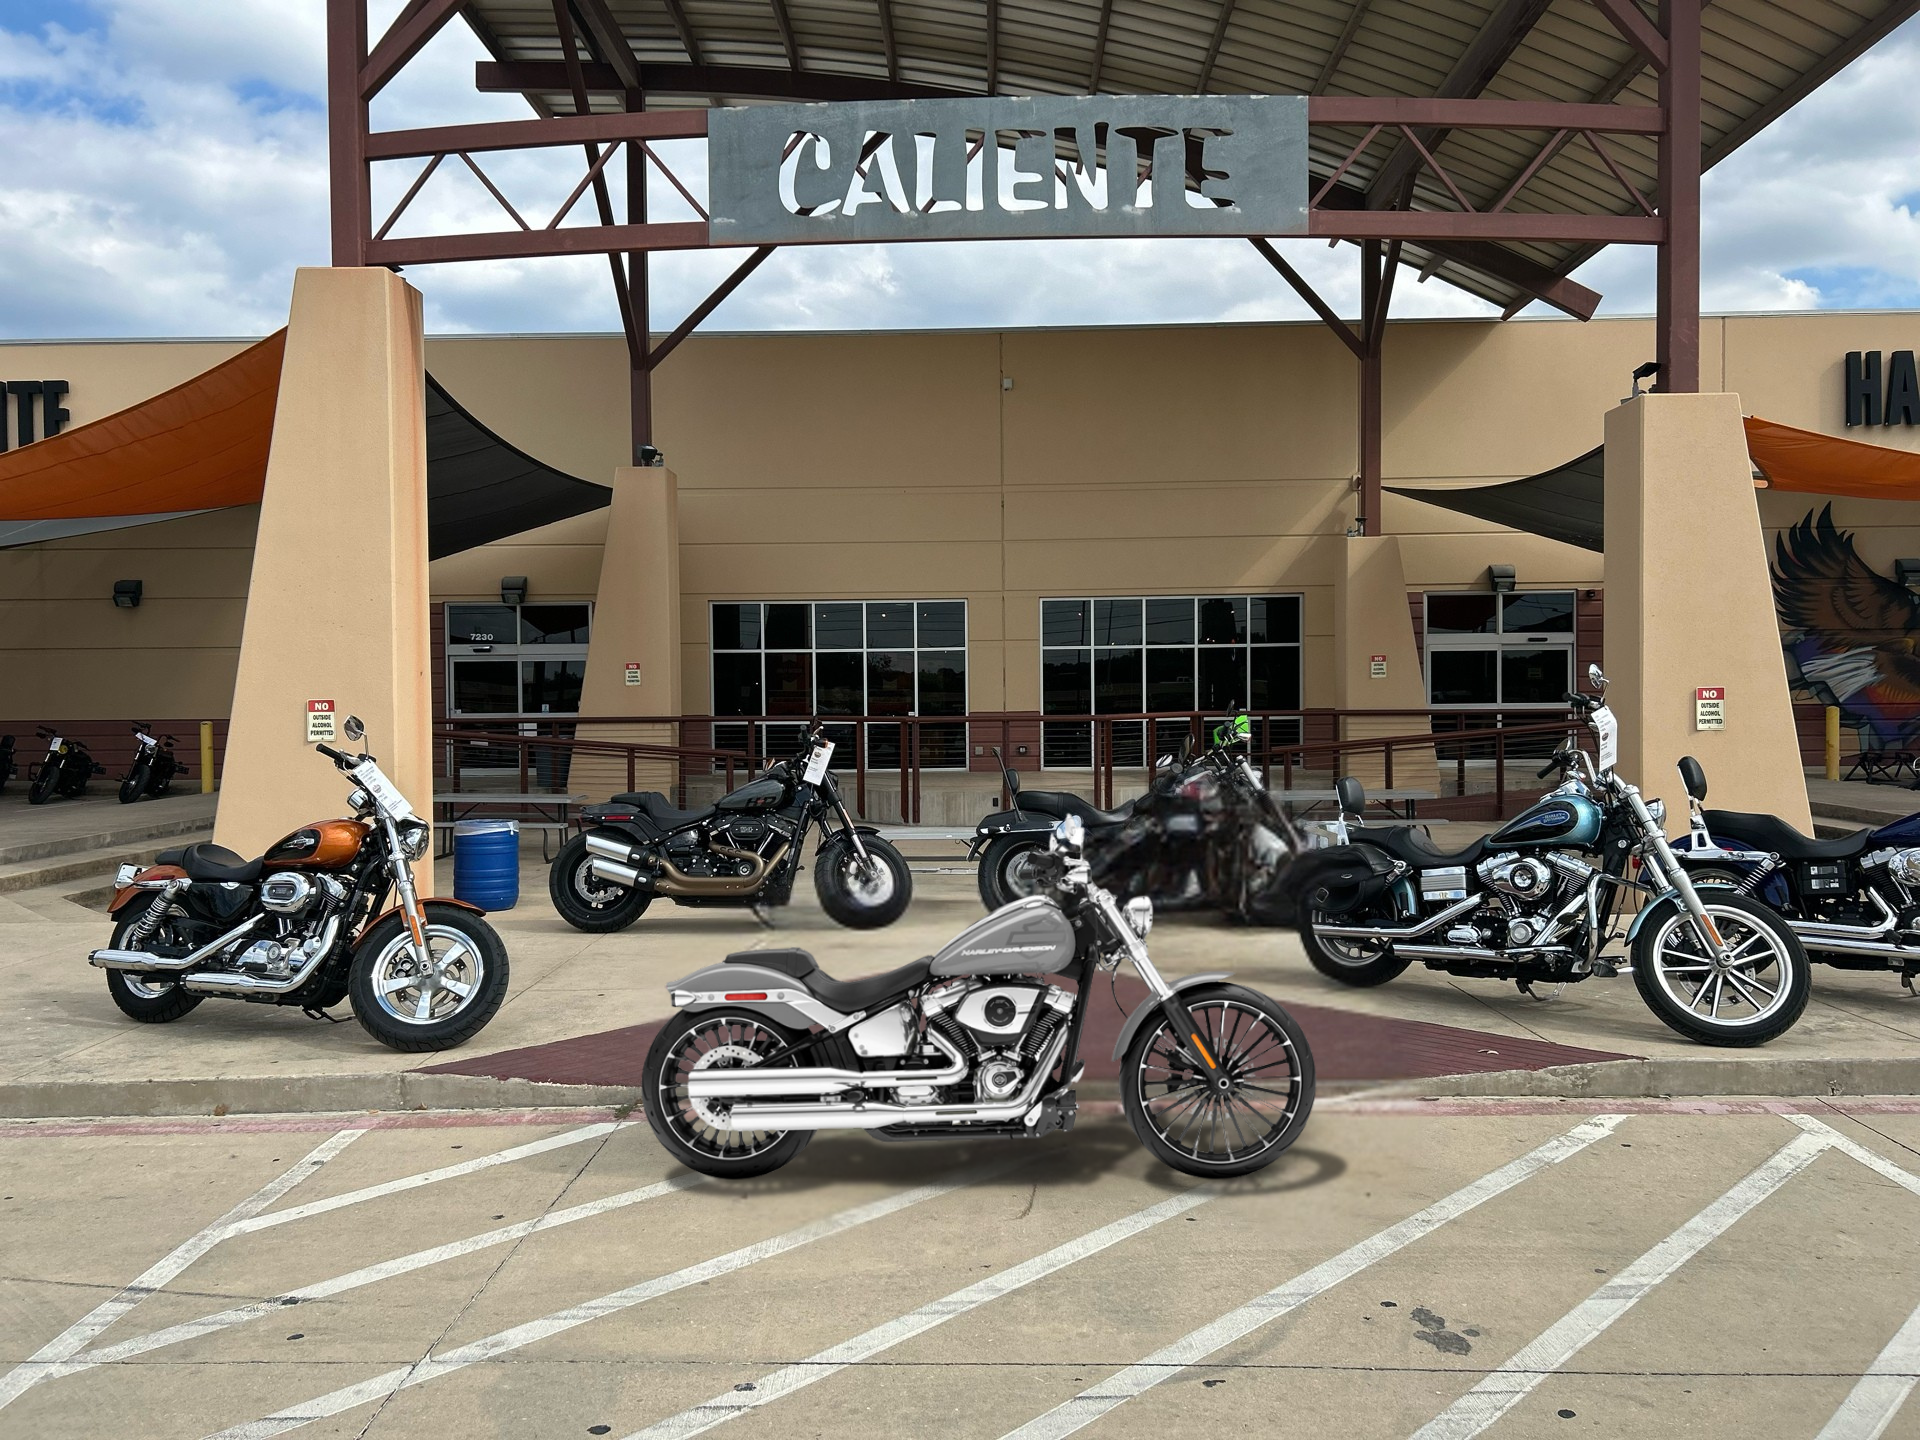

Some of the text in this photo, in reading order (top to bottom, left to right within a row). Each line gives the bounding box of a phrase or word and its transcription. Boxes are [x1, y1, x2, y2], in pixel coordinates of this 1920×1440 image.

[778, 121, 1236, 217] CALIENTE
[470, 633, 494, 641] 7230
[1702, 690, 1717, 699] NO
[314, 702, 329, 711] NO
[961, 944, 1057, 956] HARLEY-DAVIDSON
